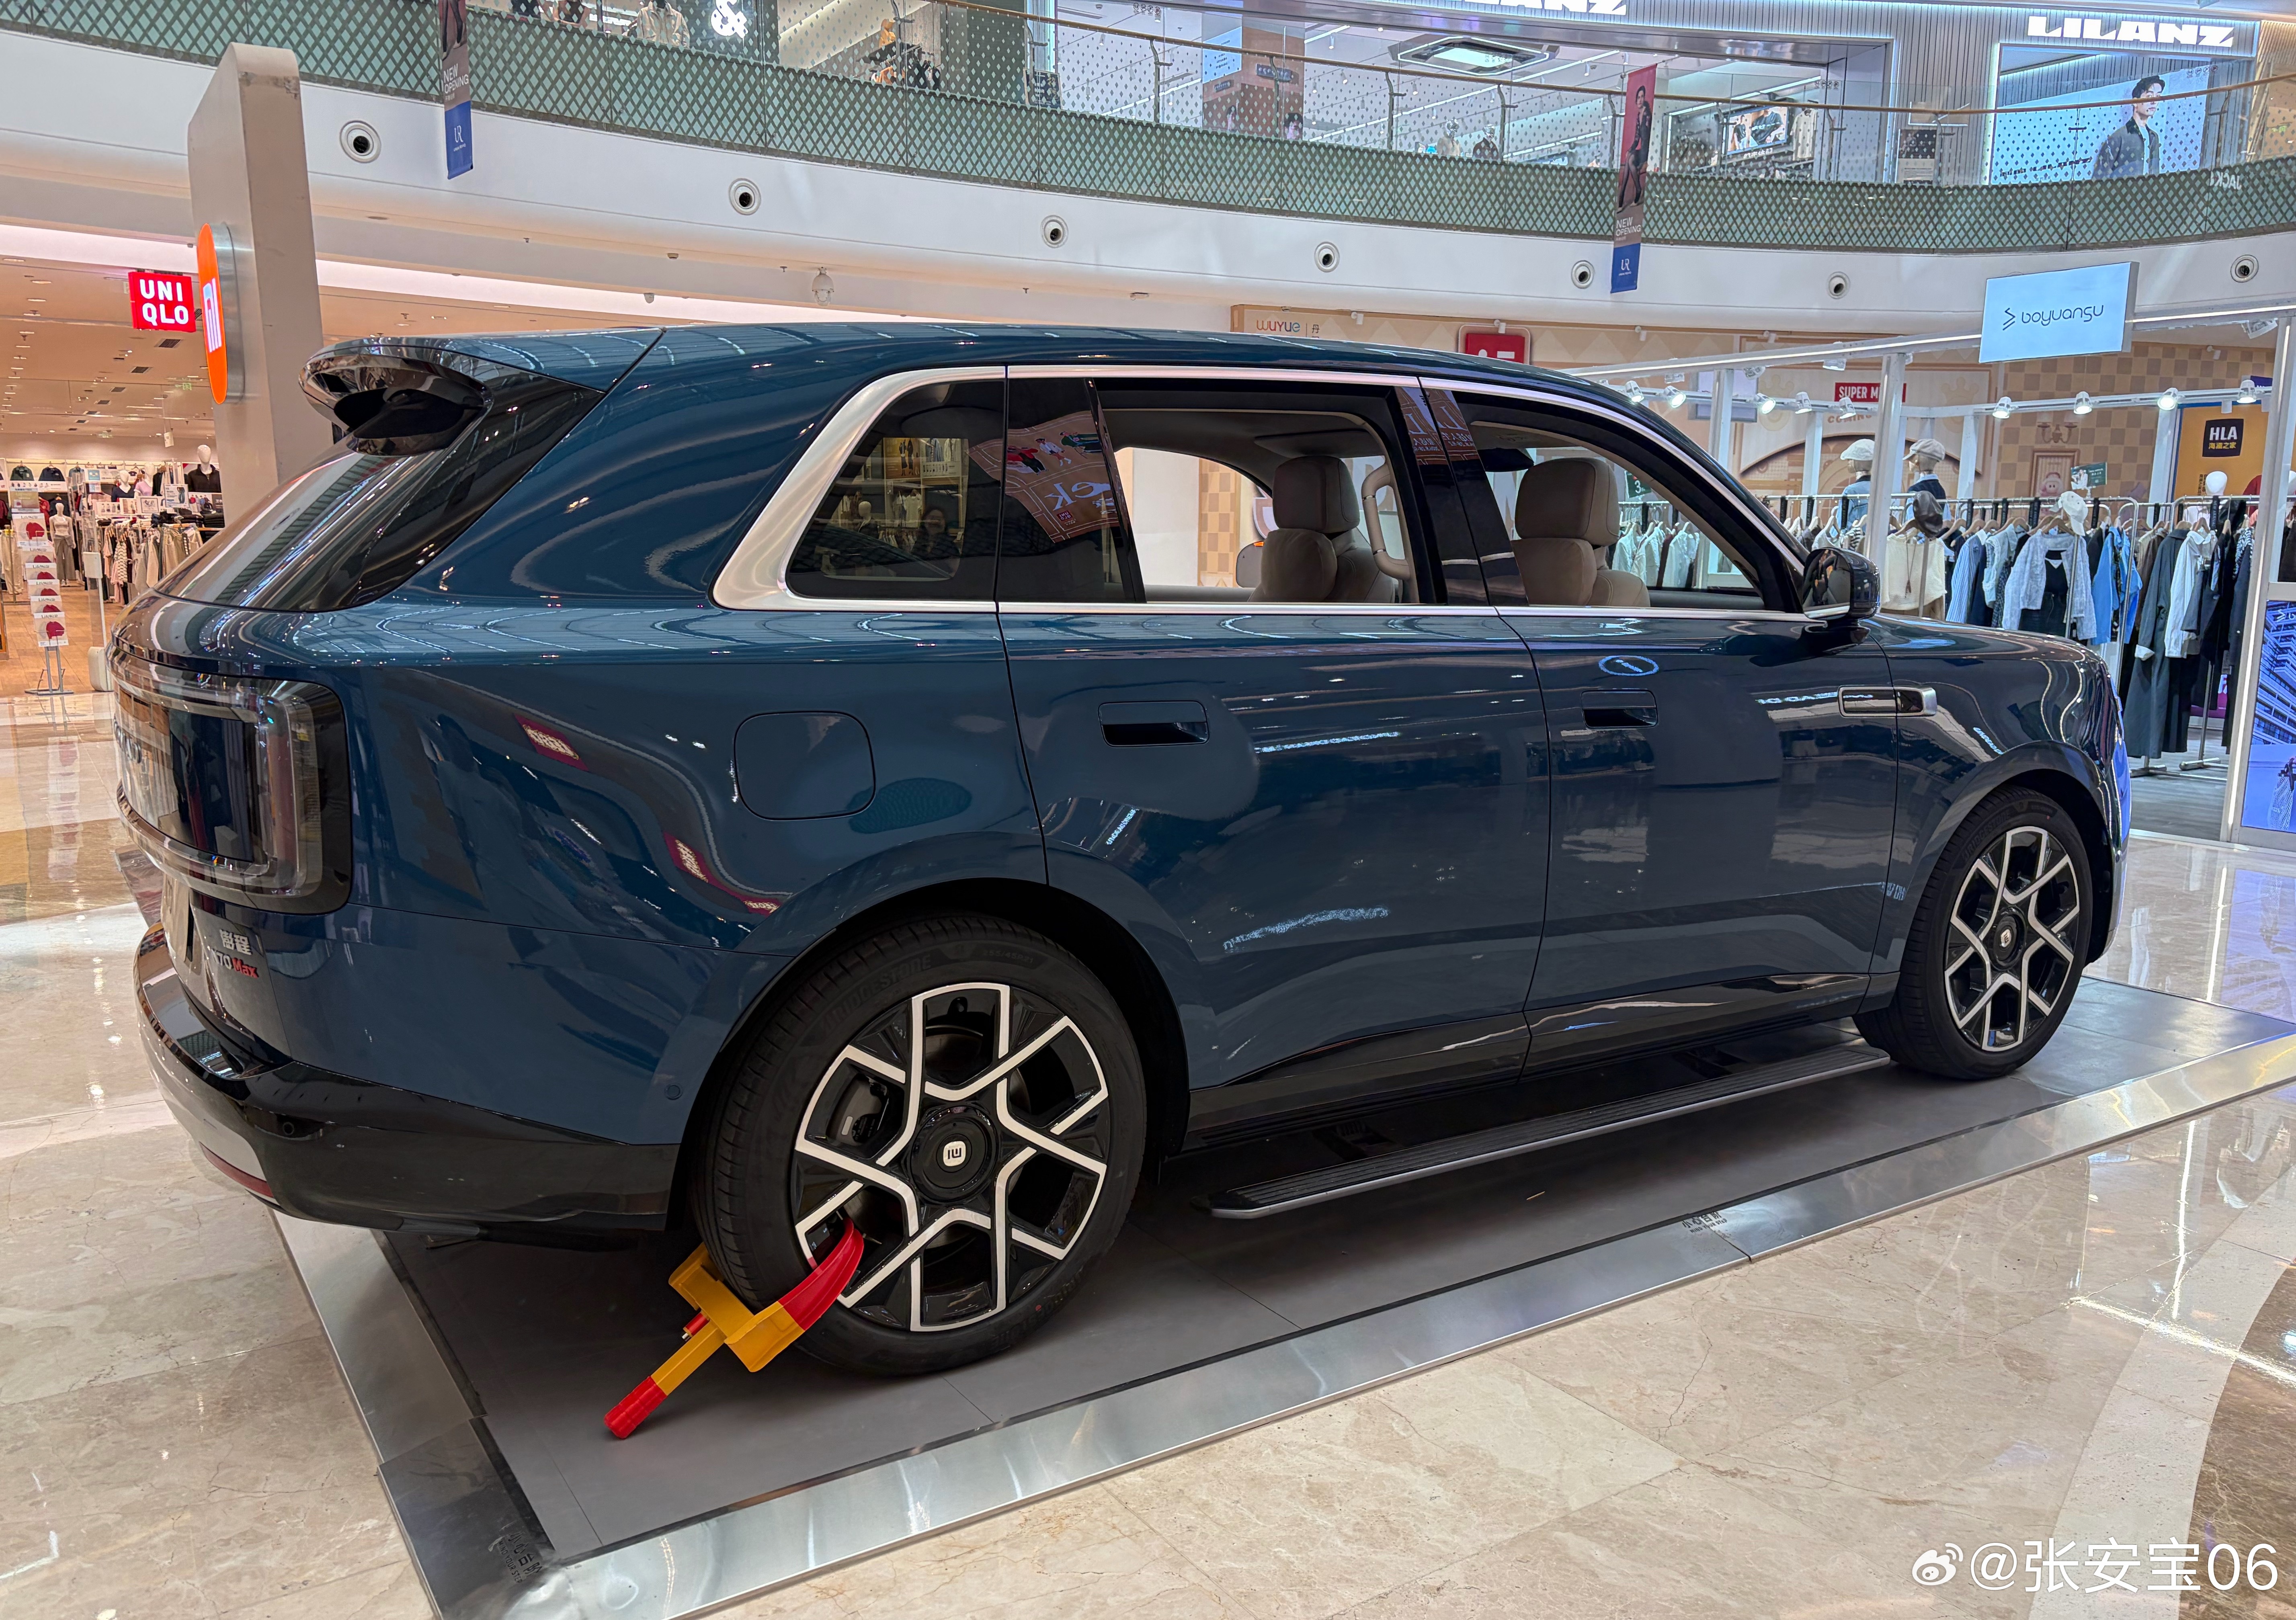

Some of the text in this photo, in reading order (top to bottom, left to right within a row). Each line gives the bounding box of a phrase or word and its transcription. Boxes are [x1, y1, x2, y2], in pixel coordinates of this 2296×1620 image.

[2028, 16, 2234, 47] LILANZ
[443, 63, 458, 83] NEW
[445, 74, 469, 94] OPENING
[1616, 217, 1633, 229] NEW
[1616, 224, 1641, 236] OPENING
[139, 279, 183, 302] UNI
[142, 303, 189, 326] QLO
[1839, 386, 1867, 399] SUPER
[2210, 426, 2237, 440] HLA
[498, 1540, 523, 1583] MIND YOUR STEP
